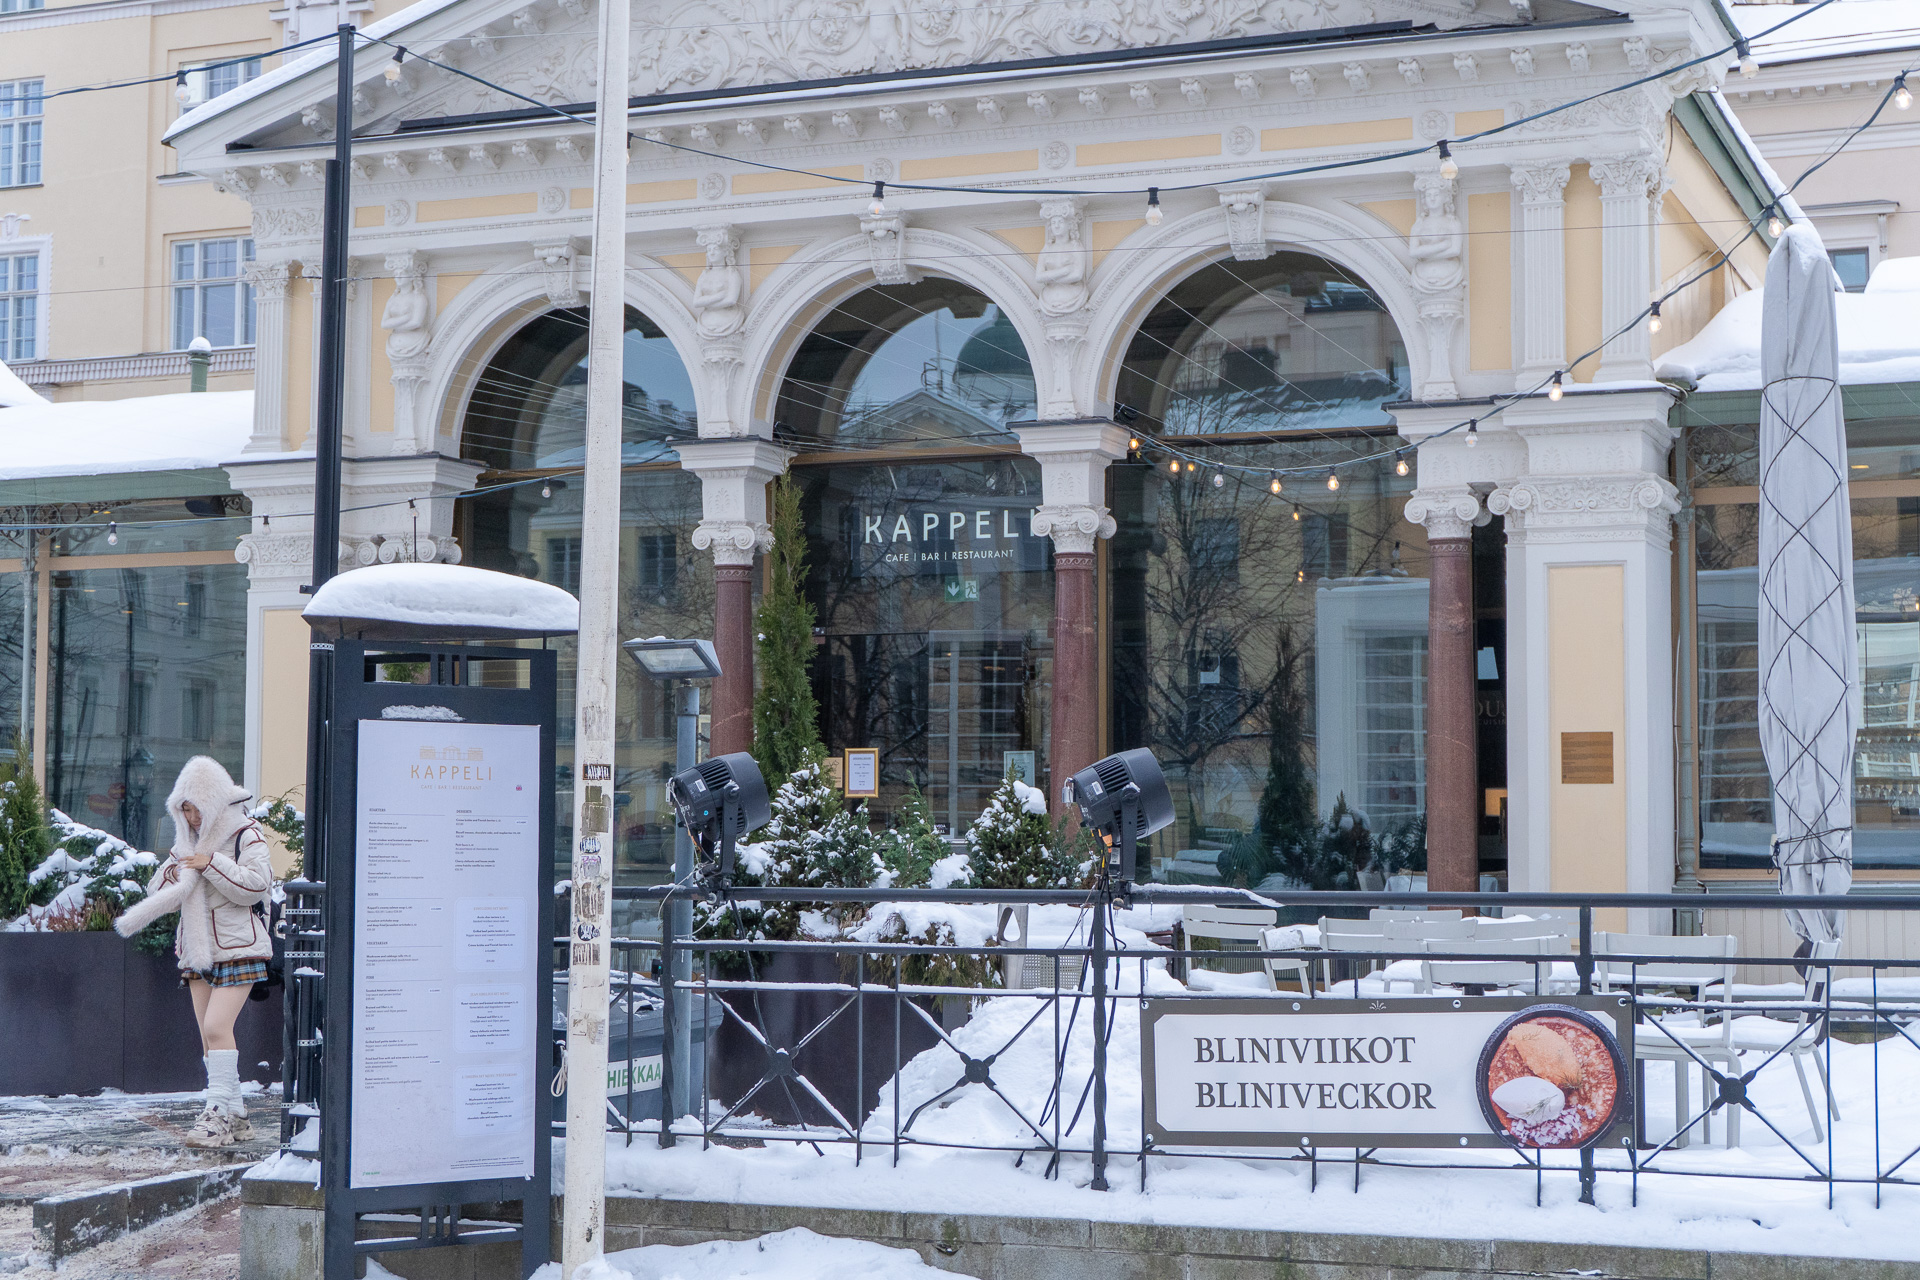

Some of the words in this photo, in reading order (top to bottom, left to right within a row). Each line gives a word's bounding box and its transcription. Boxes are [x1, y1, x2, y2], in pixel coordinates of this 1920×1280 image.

[865, 508, 1035, 543] KAPPELI
[885, 553, 909, 563] CAFE
[921, 552, 940, 562] BAR
[952, 549, 1014, 560] RESTAURANT
[411, 764, 492, 781] KAPPELI
[1193, 1036, 1416, 1064] BLINIVIIKOT
[1195, 1082, 1437, 1110] BLINIVECKOR
